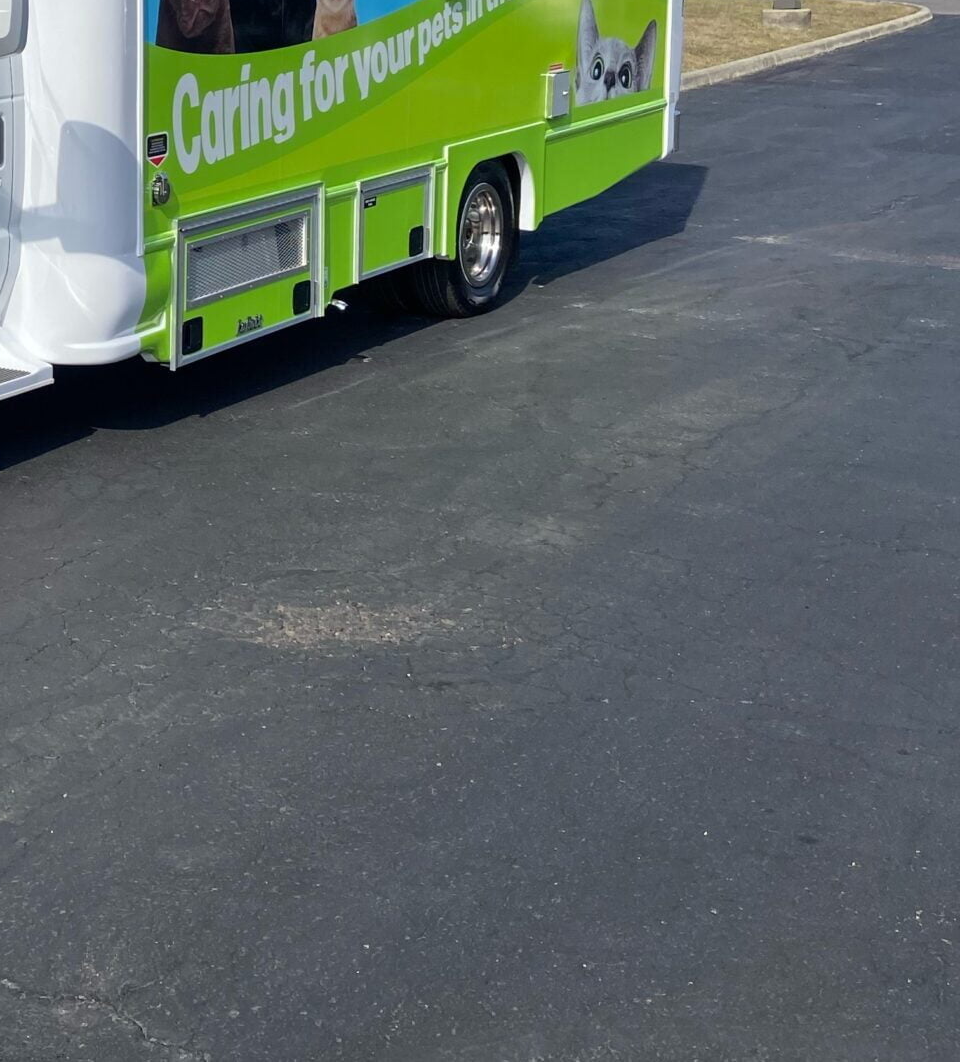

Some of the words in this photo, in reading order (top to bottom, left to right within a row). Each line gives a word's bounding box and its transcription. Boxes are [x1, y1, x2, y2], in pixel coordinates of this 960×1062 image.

[172, 63, 296, 174] Caring
[299, 50, 349, 121] for
[352, 26, 415, 100] your
[417, 1, 464, 66] pets
